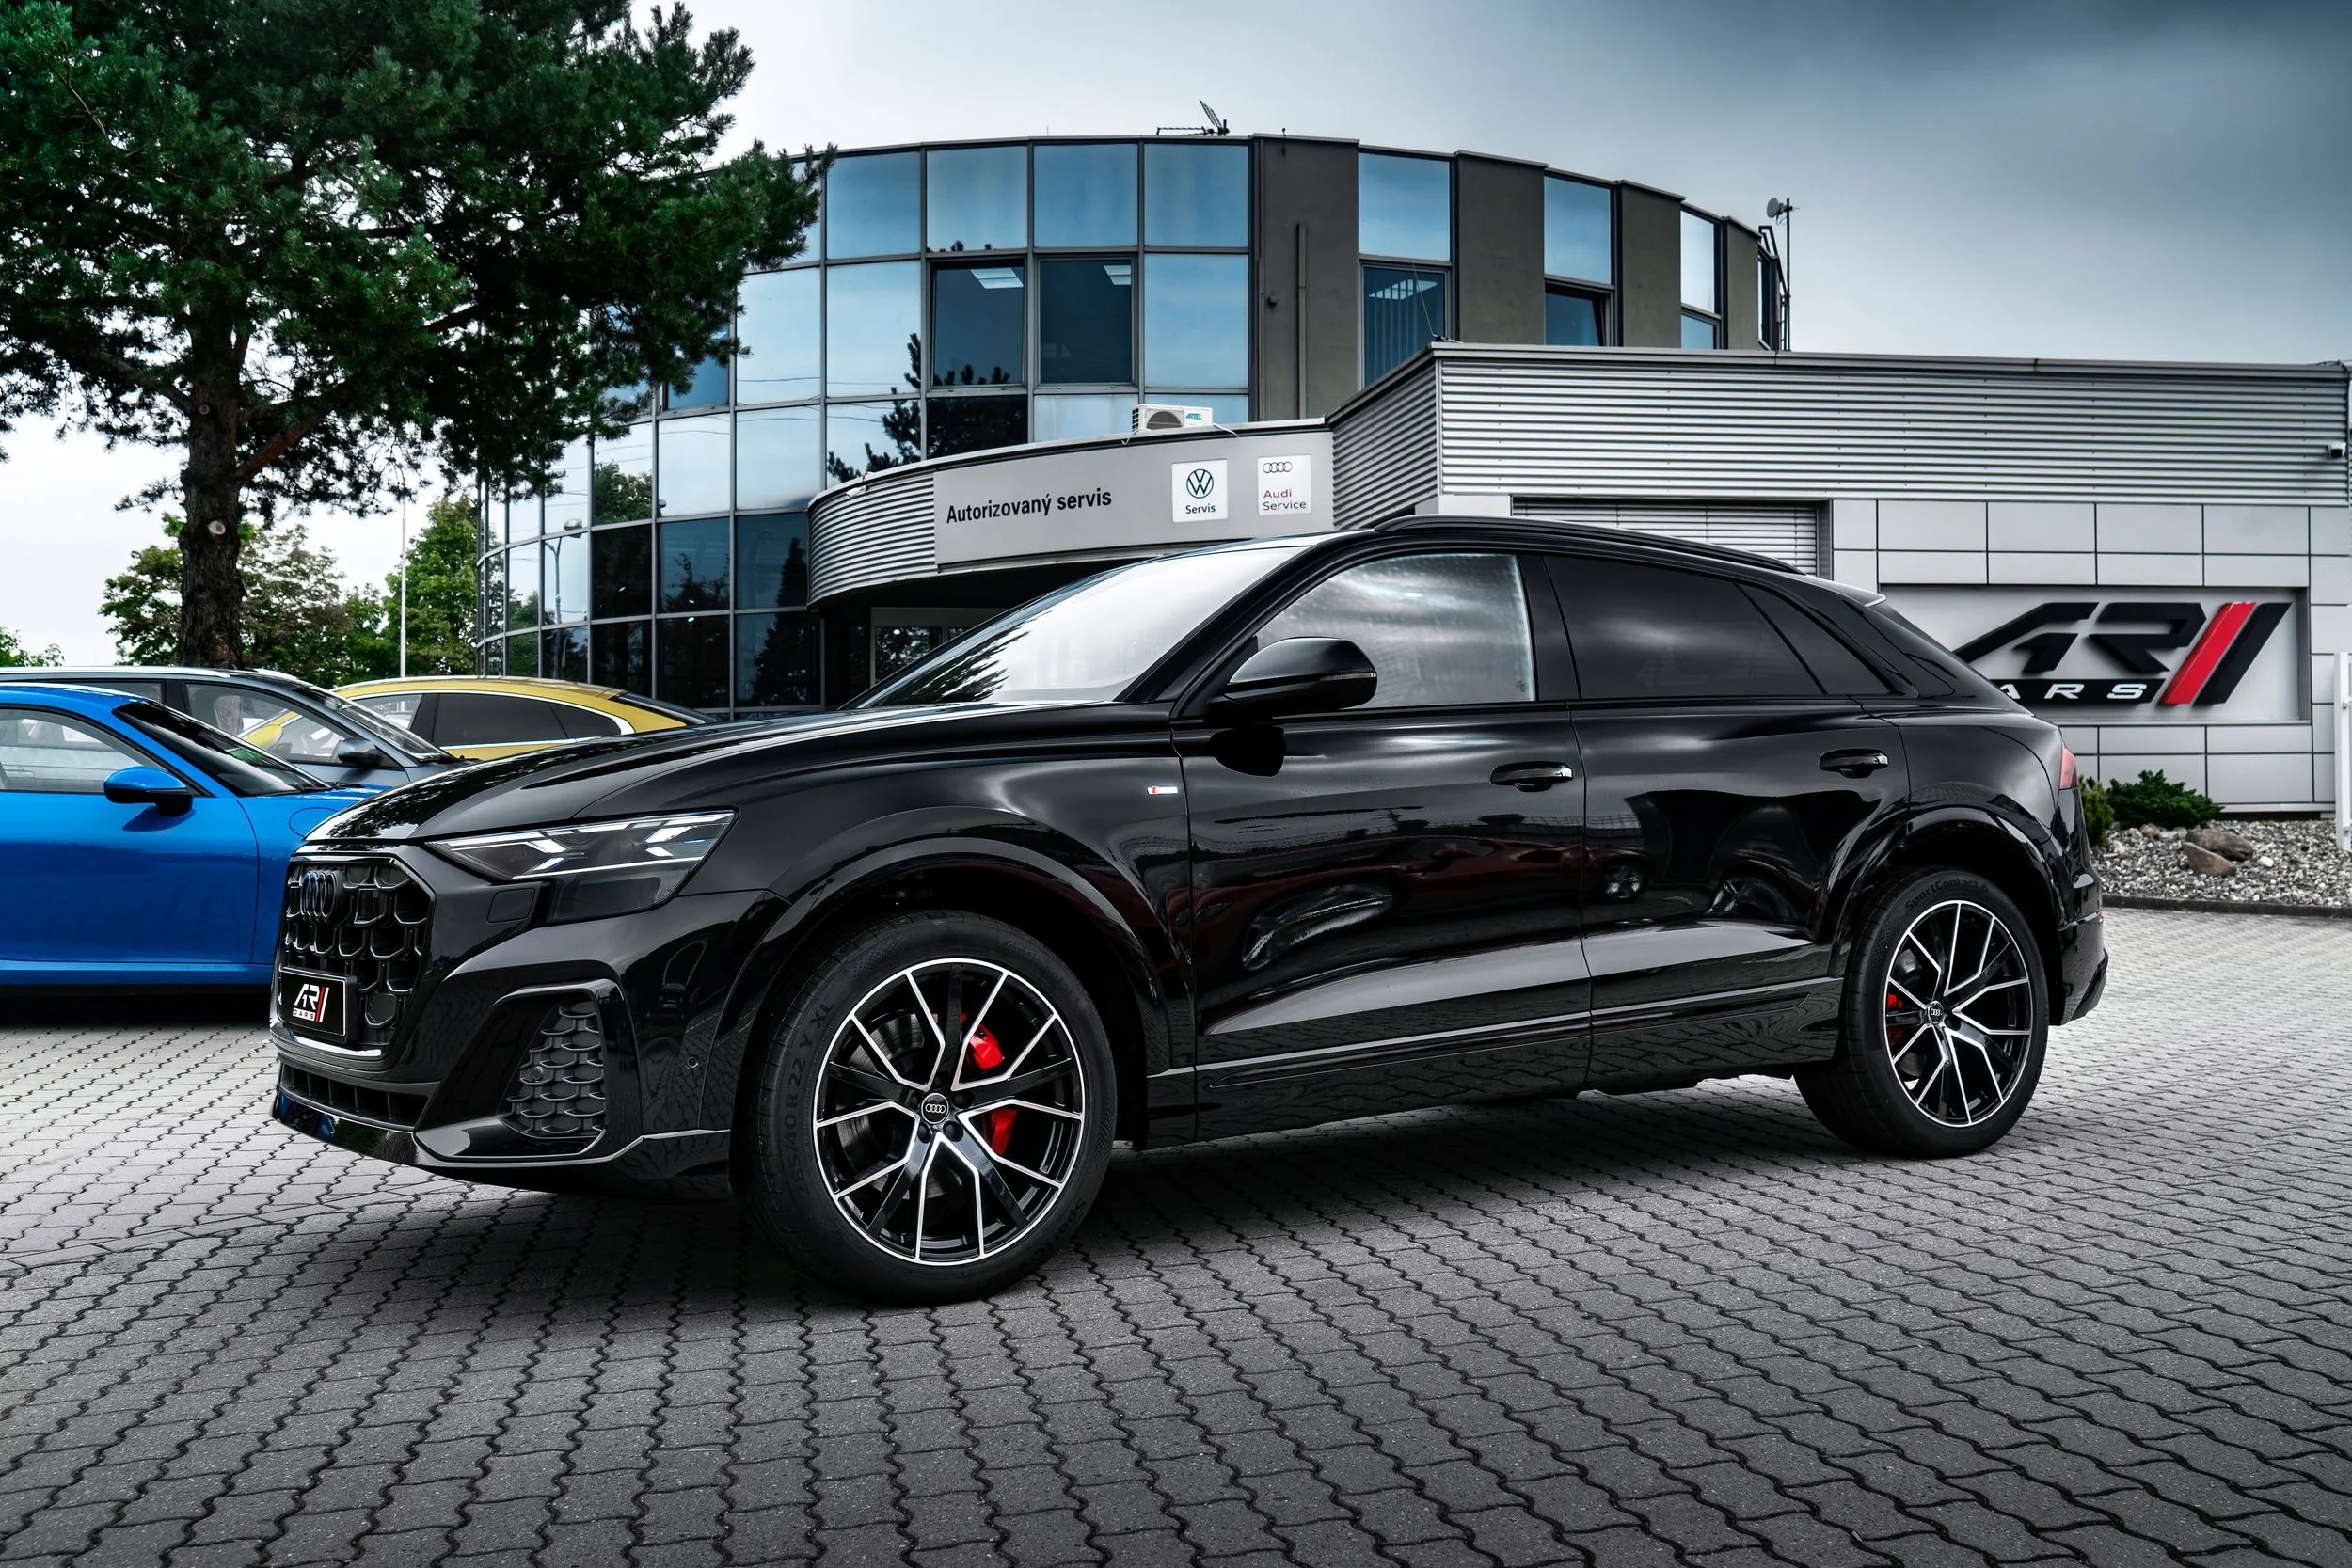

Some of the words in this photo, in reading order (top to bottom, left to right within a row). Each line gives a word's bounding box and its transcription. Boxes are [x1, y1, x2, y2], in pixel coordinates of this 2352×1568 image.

[1263, 488, 1293, 499] Audi
[946, 492, 1051, 524] Autorizovaný
[1057, 487, 1112, 510] servis
[1185, 502, 1216, 515] Servis
[1263, 499, 1307, 512] Service
[1999, 683, 2148, 700] ARS
[294, 1009, 315, 1020] CARS
[808, 998, 835, 1030] XL
